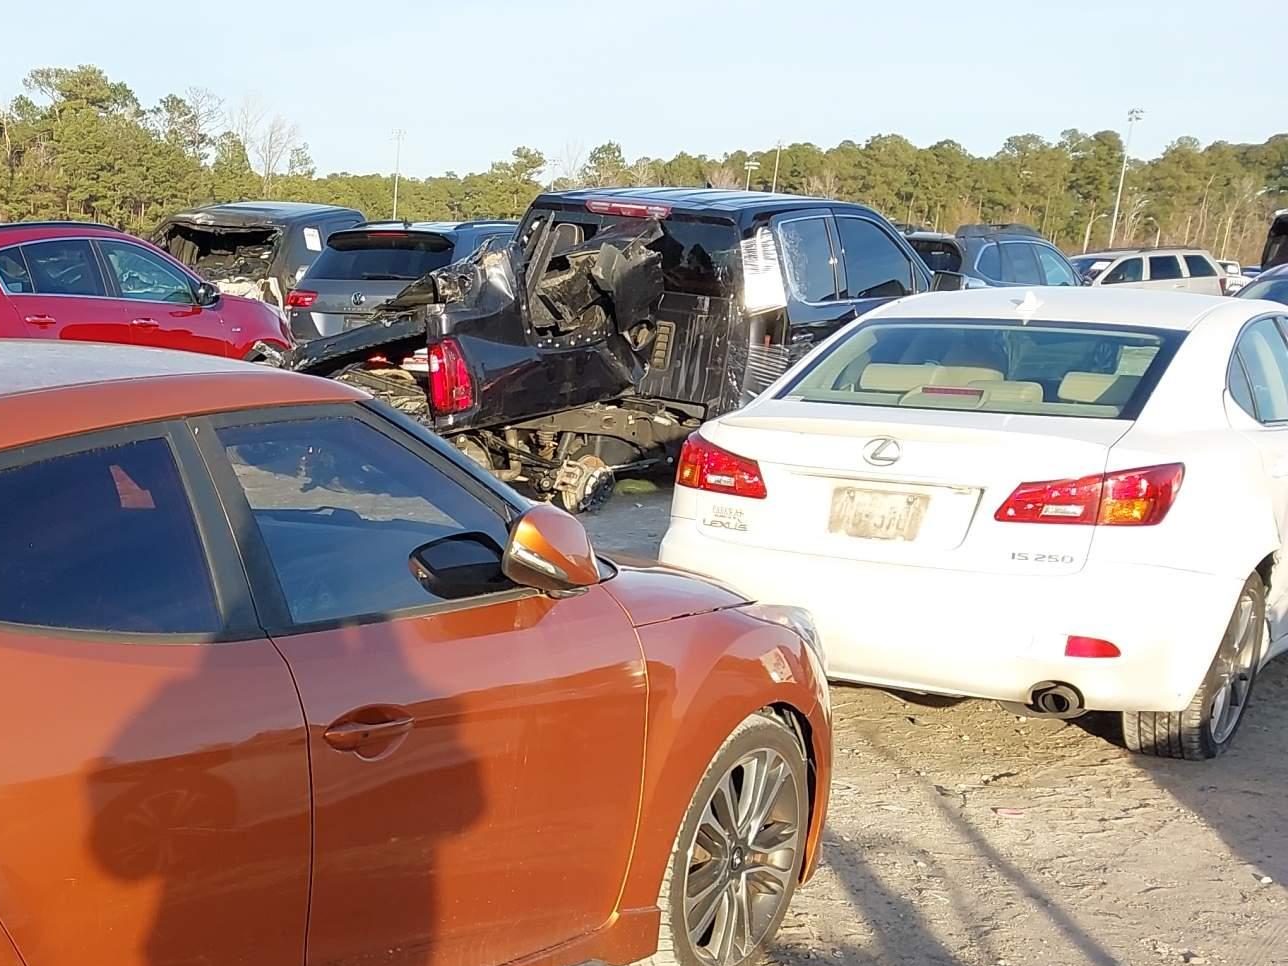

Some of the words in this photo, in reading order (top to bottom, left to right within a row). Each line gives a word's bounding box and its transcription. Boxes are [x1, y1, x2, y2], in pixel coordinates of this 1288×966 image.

[703, 517, 748, 532] LEXUS
[1011, 552, 1029, 561] IS
[1034, 553, 1074, 564] 250
